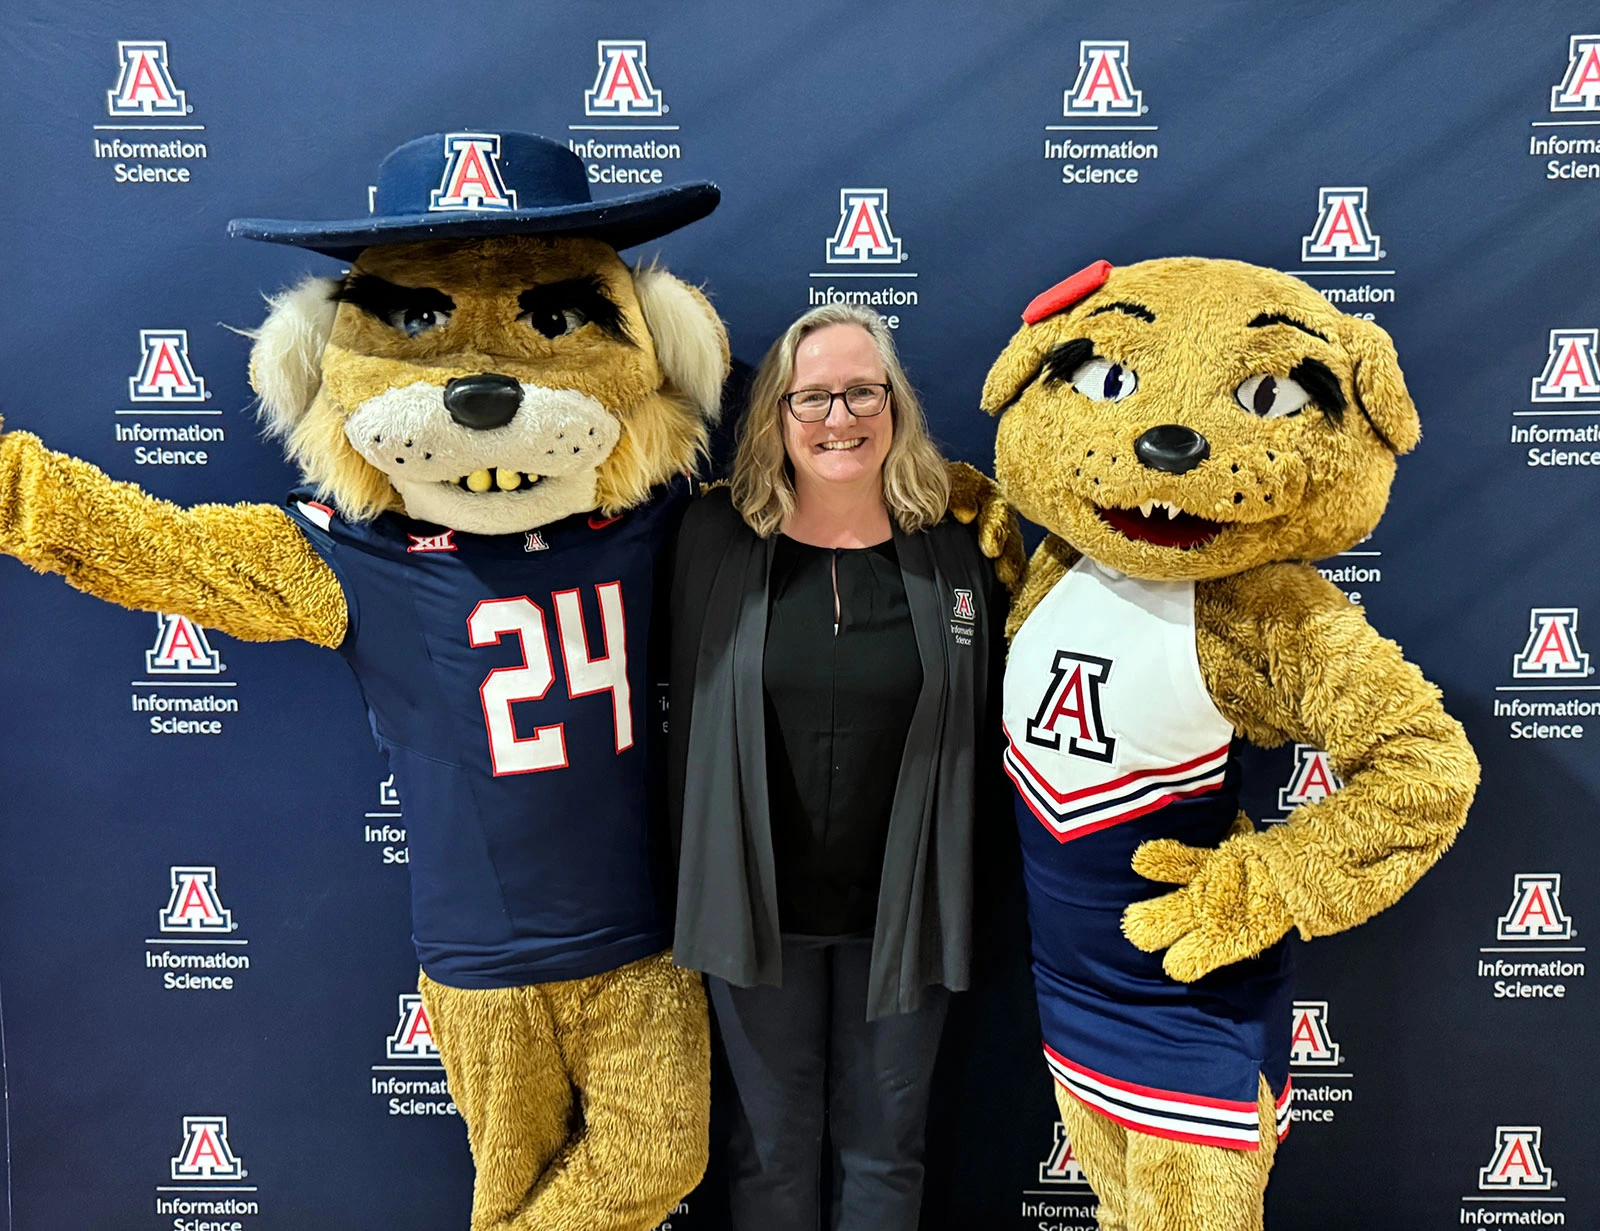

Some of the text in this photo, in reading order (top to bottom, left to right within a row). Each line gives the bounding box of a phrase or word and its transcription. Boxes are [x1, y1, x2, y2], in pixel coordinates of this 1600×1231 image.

[108, 41, 186, 116] A
[585, 41, 662, 116] A
[1064, 41, 1143, 116] A
[94, 138, 207, 159] Information
[569, 139, 681, 159] Information
[1044, 139, 1158, 159] Information
[114, 163, 190, 183] Science
[428, 132, 518, 213] A
[588, 164, 663, 184] Science
[1062, 164, 1139, 184] Science
[827, 189, 901, 263] A
[1302, 187, 1380, 261] A
[808, 287, 919, 305] Information
[130, 330, 204, 401] A
[1531, 329, 1600, 402] A
[115, 423, 225, 442] Information
[1511, 424, 1600, 443] Informati
[134, 446, 208, 465] Science
[1527, 448, 1600, 467] Science
[407, 529, 458, 553] XII
[953, 588, 976, 620] A
[1514, 608, 1590, 677] A
[466, 580, 634, 777] 24
[132, 694, 238, 712] Information
[1026, 650, 1116, 765] A
[150, 716, 222, 734] Science
[1510, 721, 1584, 739] Science
[160, 867, 231, 932] A
[1497, 874, 1574, 939] A
[146, 950, 250, 969] Information
[1478, 959, 1585, 977] Information
[163, 972, 234, 990] Science
[1493, 980, 1566, 998] Science
[388, 1097, 457, 1116] Science
[172, 1117, 243, 1179] A
[1479, 1127, 1553, 1189] A
[156, 1198, 258, 1215] Information
[1460, 1208, 1565, 1225] Information
[173, 1218, 242, 1231] Science
